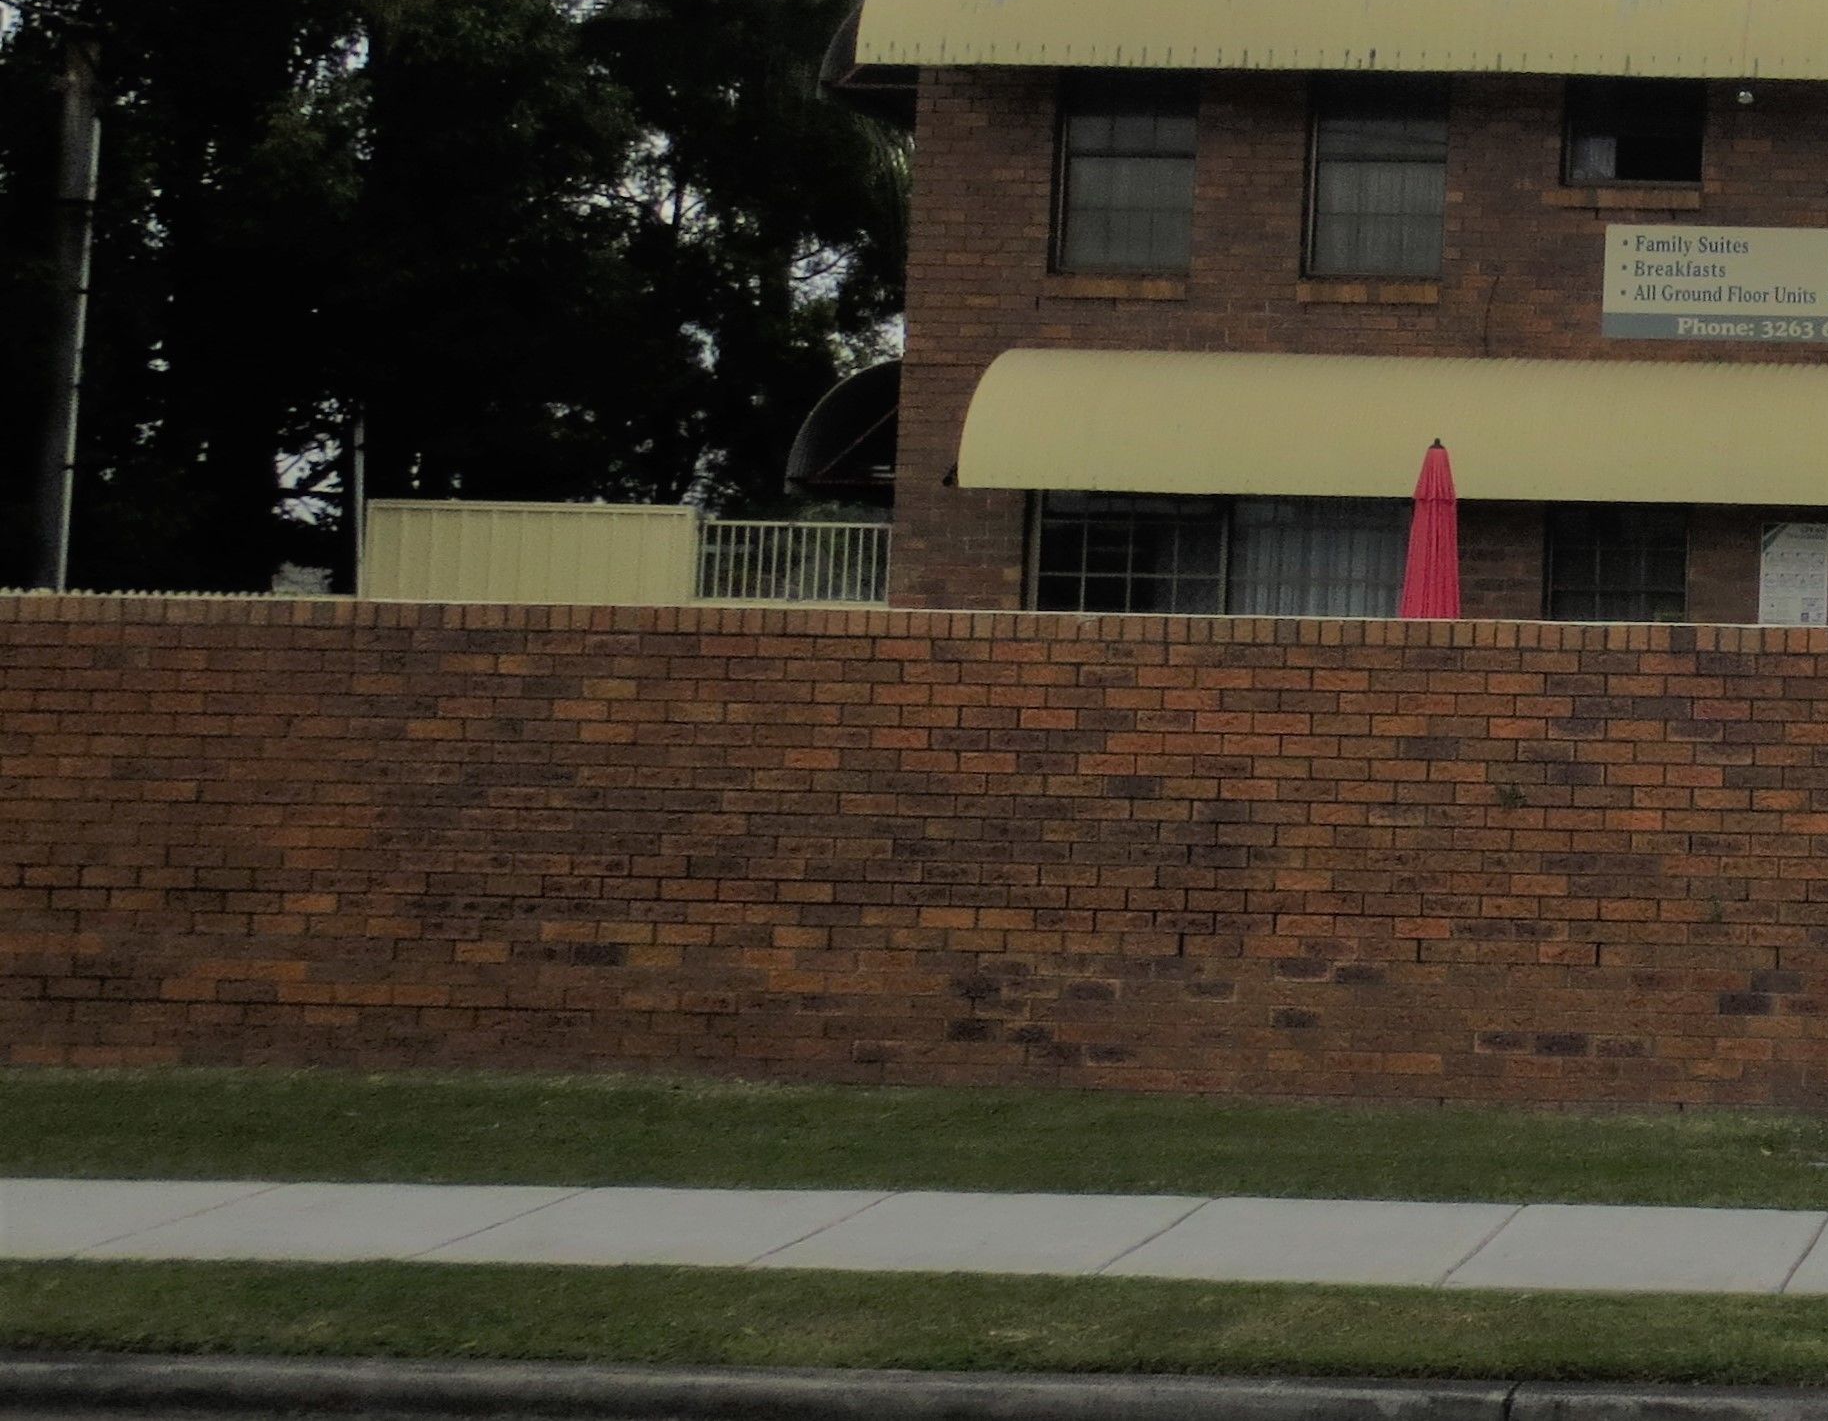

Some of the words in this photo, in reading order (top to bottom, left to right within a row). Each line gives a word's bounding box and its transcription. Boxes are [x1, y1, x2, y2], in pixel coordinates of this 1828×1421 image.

[1635, 235, 1692, 257] Family
[1699, 236, 1749, 254] Suites
[1634, 260, 1726, 277] Breakfasts
[1634, 284, 1656, 301] All
[1662, 284, 1722, 302] Ground
[1727, 286, 1769, 303] Floor
[1774, 286, 1816, 304] Units
[1677, 317, 1754, 336] Phone:
[1761, 320, 1814, 339] 3263
